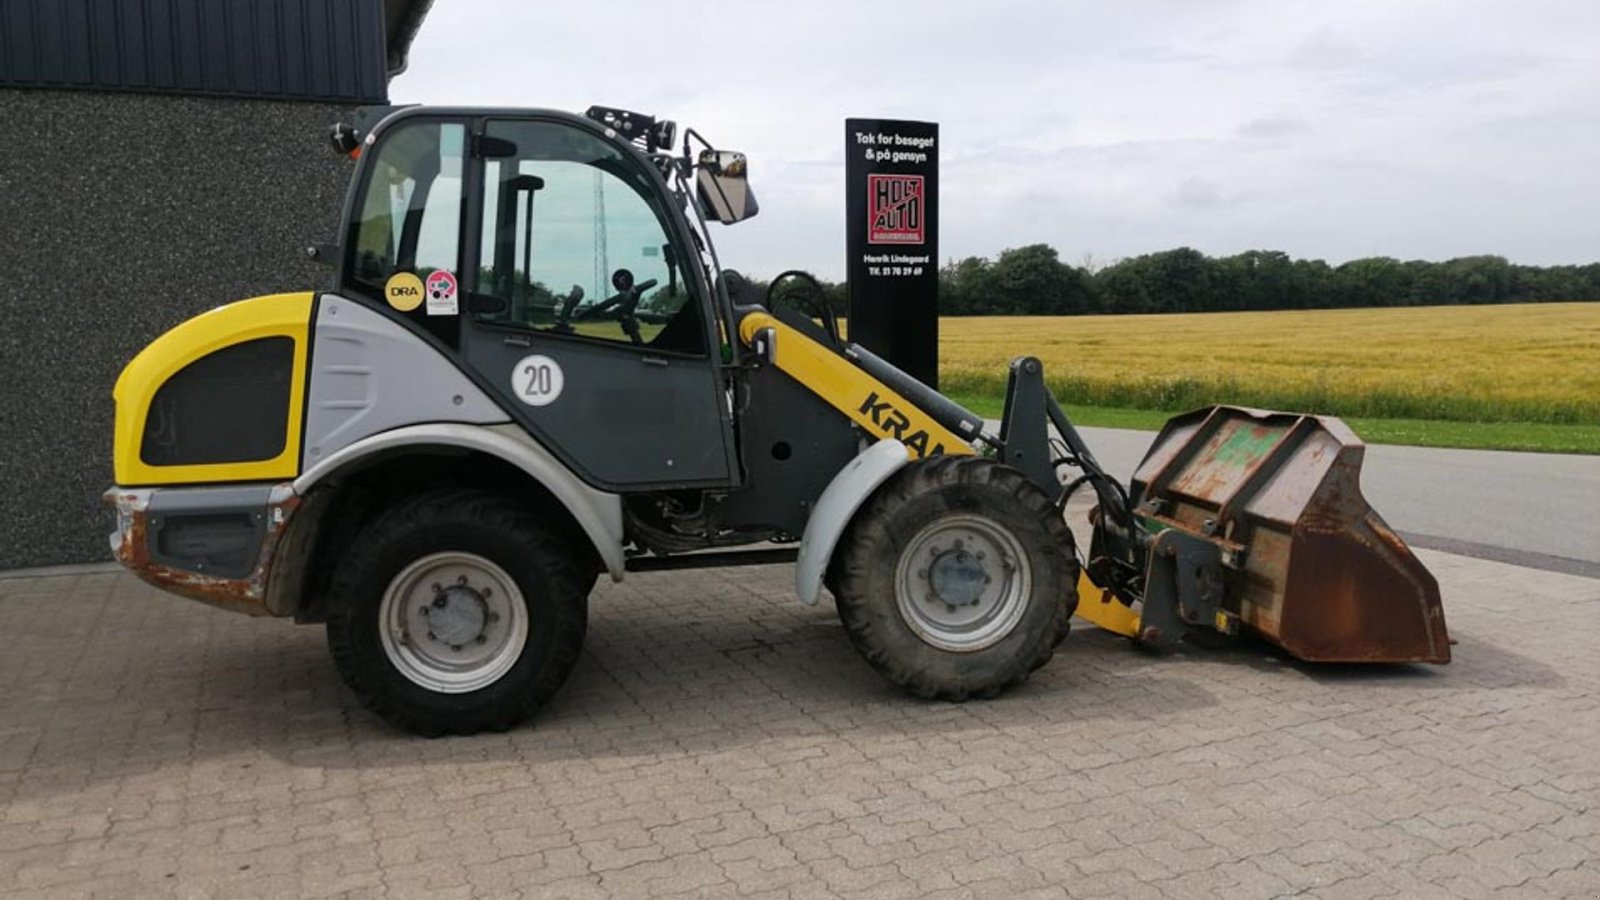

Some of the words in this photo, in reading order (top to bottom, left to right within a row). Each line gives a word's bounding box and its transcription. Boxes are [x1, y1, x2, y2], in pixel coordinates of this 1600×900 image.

[856, 132, 875, 144] Tak
[877, 132, 893, 144] for
[865, 148, 874, 160] &
[876, 149, 891, 163] på
[892, 151, 927, 164] gensyn
[876, 179, 917, 212] HOLT
[875, 197, 919, 229] AUTO
[864, 254, 889, 263] Henrik
[890, 254, 930, 265] Lindegaard
[391, 287, 418, 296] DRA
[524, 364, 552, 396] 20
